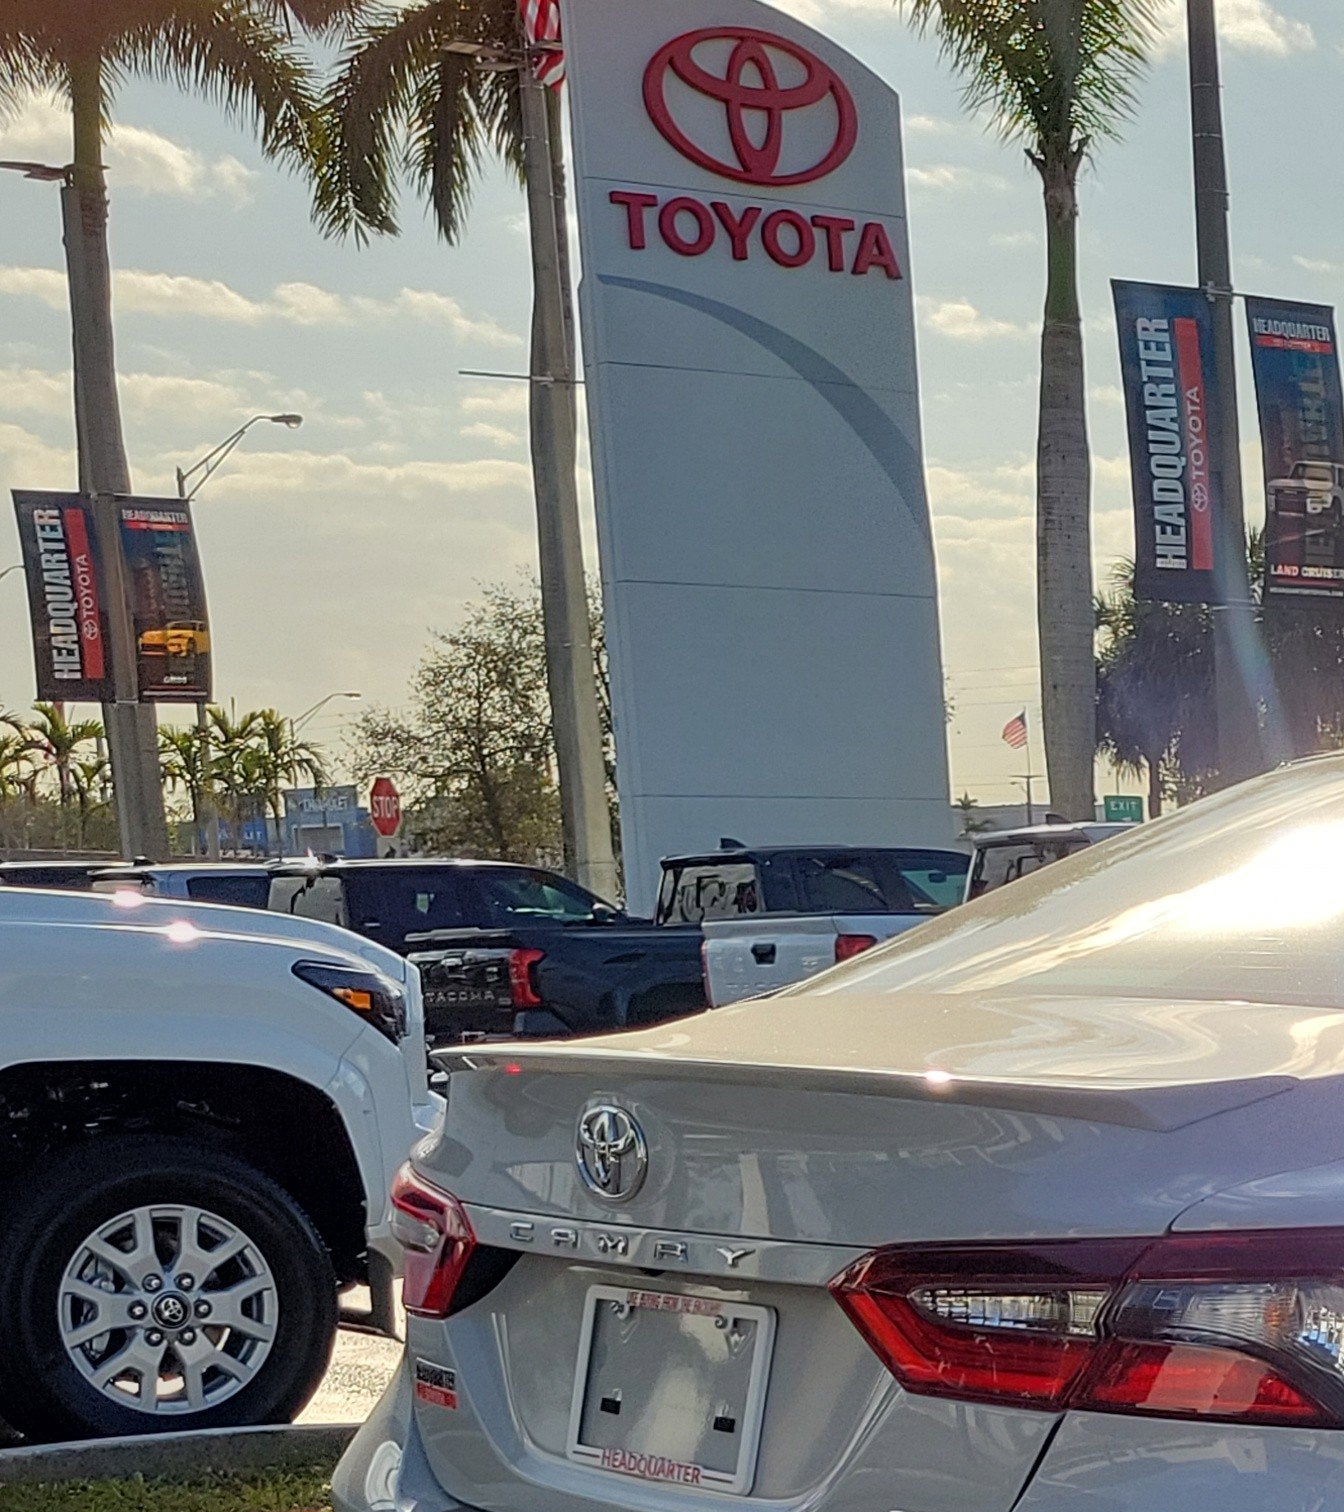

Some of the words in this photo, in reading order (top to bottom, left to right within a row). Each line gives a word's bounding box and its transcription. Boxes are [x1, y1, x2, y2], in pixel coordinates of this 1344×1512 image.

[609, 191, 903, 280] TOYOTA
[1136, 317, 1187, 570] HEADQUARTER
[1185, 386, 1206, 480] TOYOTA
[33, 507, 83, 679] HEADQUARTER
[76, 553, 96, 618] TOYOTA
[1270, 564, 1300, 577] LAND
[373, 795, 399, 819] STOP
[1110, 801, 1138, 811] EXIT
[425, 990, 495, 1003] TACOMA
[510, 1221, 756, 1267] CAMRY
[601, 1449, 702, 1483] HEADQUARTER
